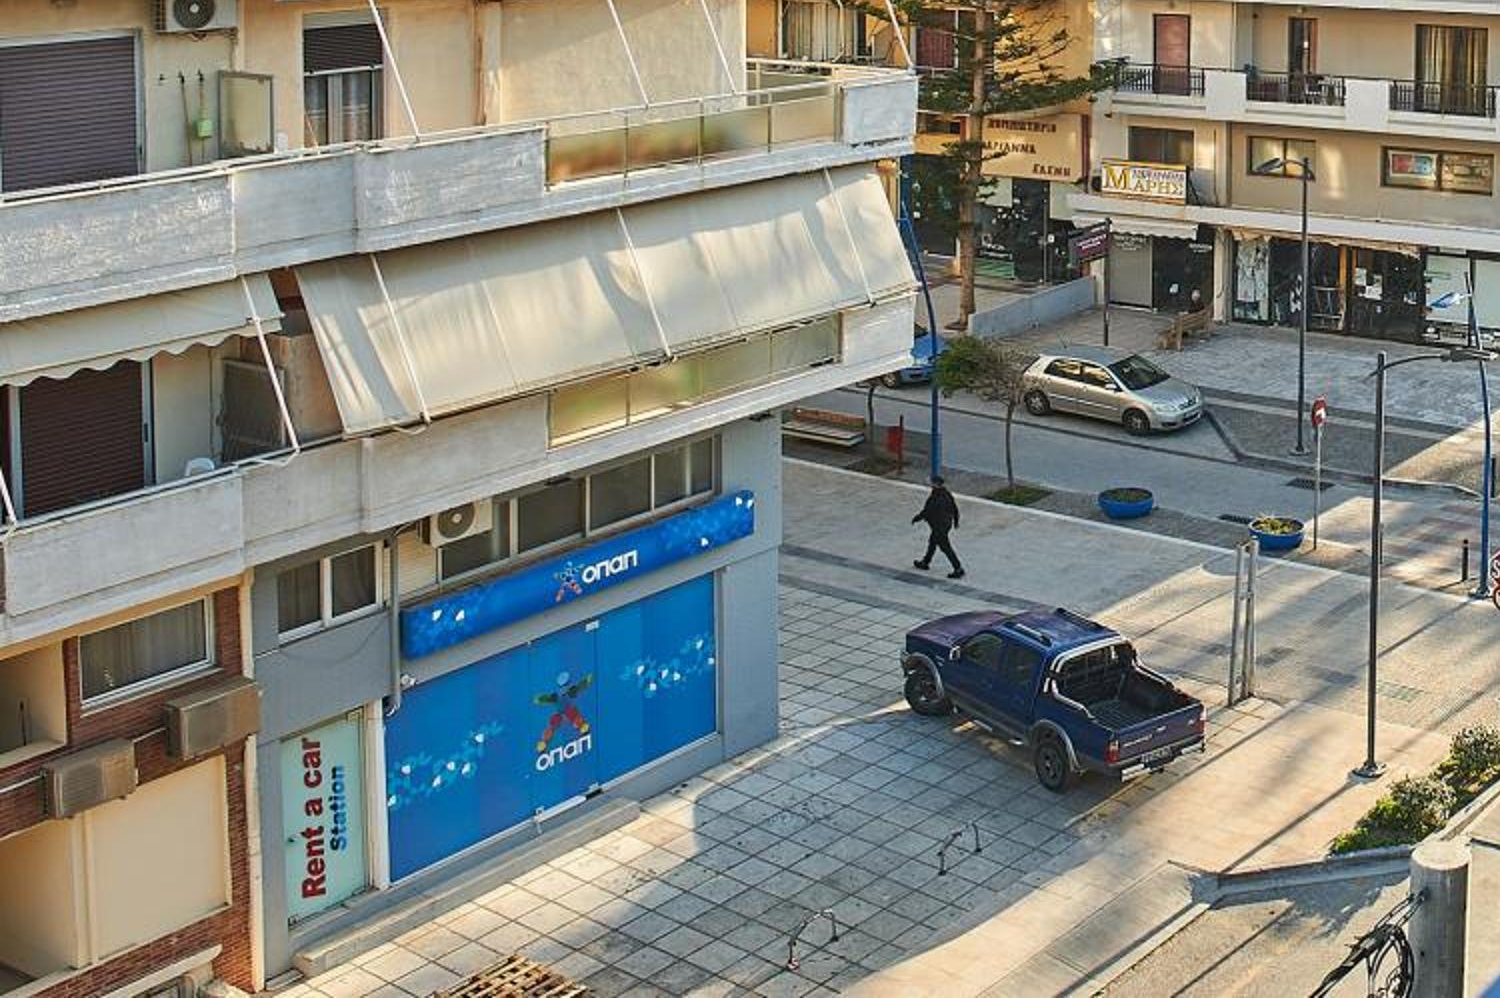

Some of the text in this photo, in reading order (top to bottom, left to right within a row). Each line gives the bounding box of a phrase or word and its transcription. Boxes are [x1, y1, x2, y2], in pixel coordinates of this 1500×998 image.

[301, 737, 327, 899] Rent a car
[328, 764, 348, 851] Station
